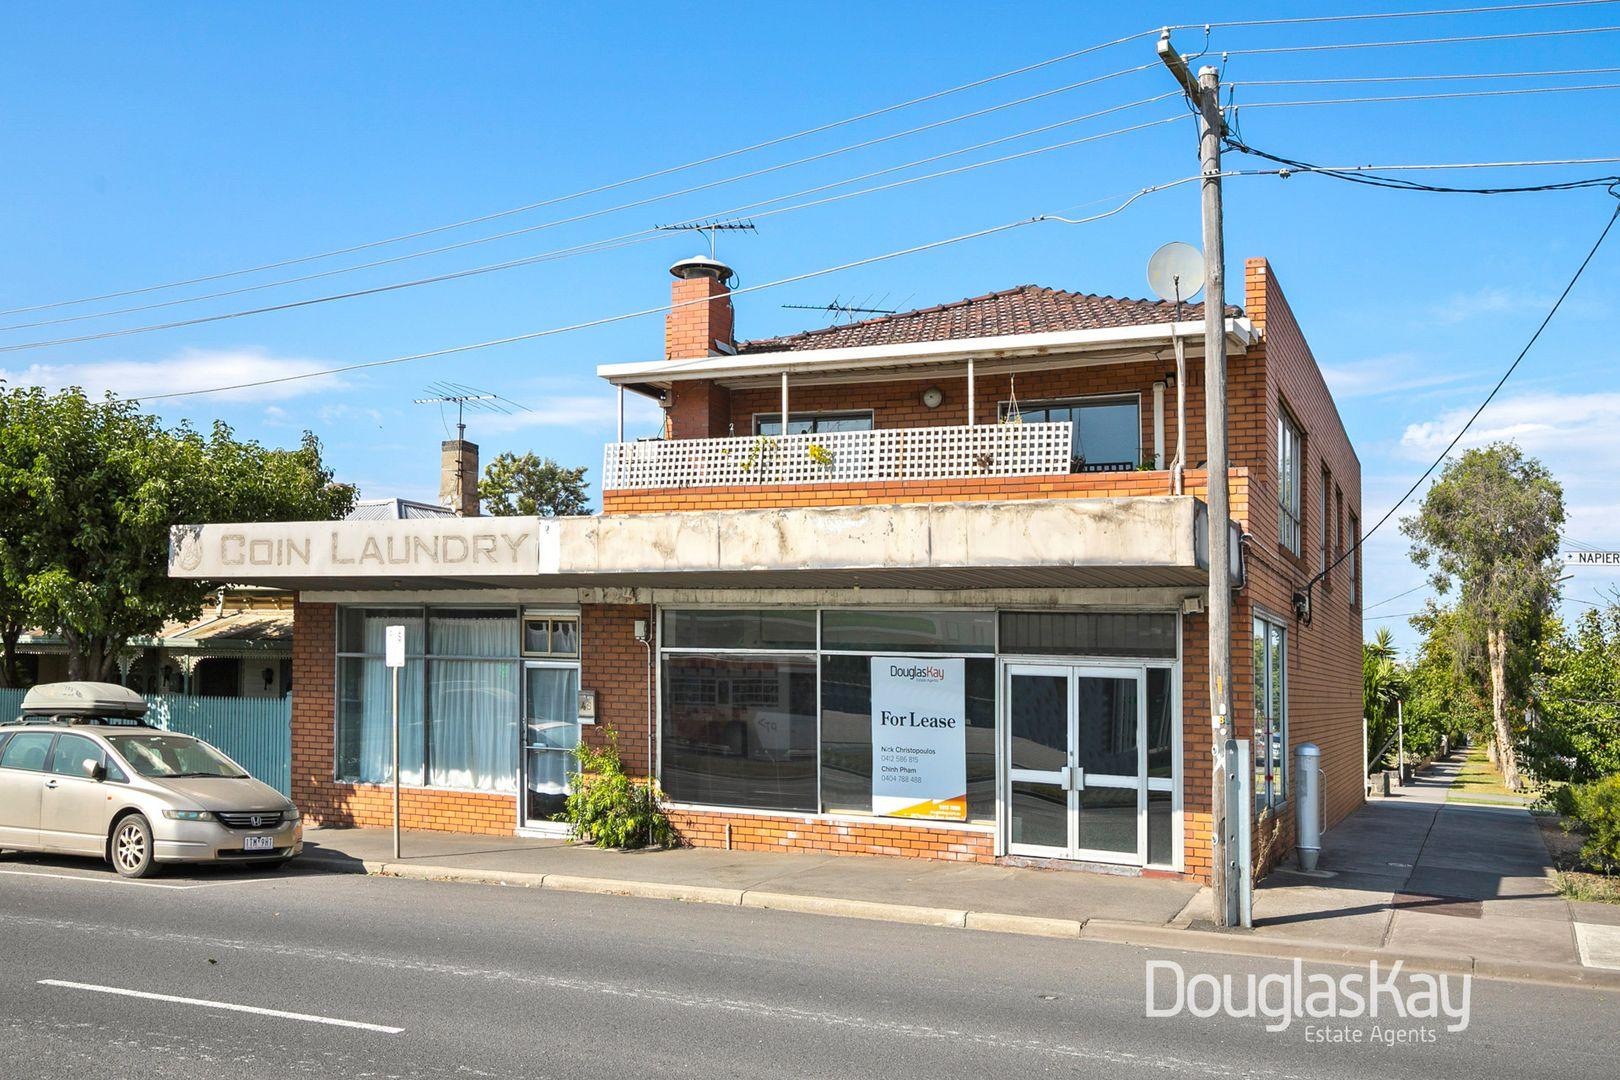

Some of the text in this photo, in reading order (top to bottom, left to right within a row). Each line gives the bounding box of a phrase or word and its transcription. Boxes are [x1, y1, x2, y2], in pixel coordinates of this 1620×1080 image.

[220, 531, 530, 566] COIN LAUNDRY
[1579, 552, 1620, 564] NAPIER
[890, 665, 944, 680] DouglasKay
[881, 711, 956, 728] For Lease
[895, 746, 936, 755] Christopoulos
